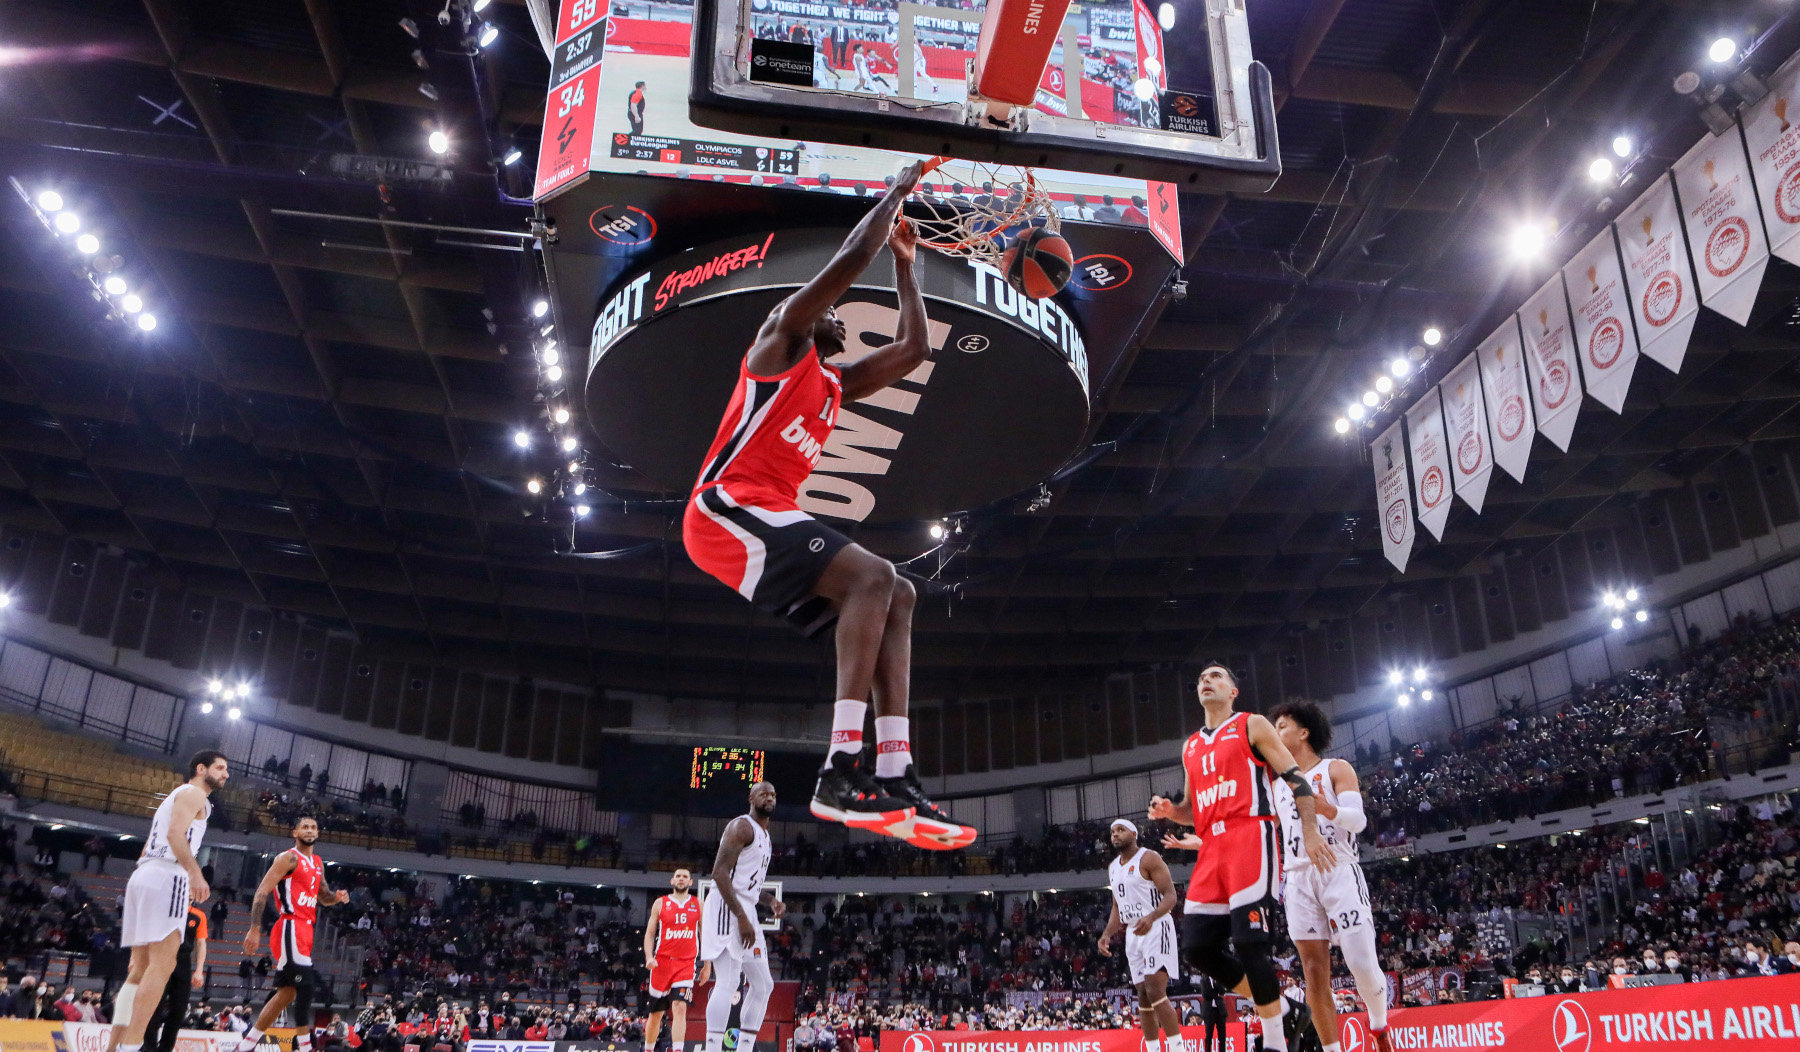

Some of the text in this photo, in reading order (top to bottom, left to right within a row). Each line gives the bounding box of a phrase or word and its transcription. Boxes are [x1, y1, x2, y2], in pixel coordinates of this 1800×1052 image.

[571, 0, 597, 29] 59
[770, 1, 885, 22] TOGETHER WE FIGHT
[1023, 0, 1044, 35] INES
[566, 31, 593, 62] 2:37
[768, 61, 812, 71] oneteam
[558, 79, 585, 118] 34
[1168, 115, 1208, 127] TURKISH
[1168, 122, 1209, 134] AIRLINES
[630, 135, 655, 143] TURKISH
[630, 140, 668, 149] EuroLeague
[636, 150, 653, 159] 2:37
[667, 153, 675, 161] 12
[695, 143, 793, 161] OLYMPIACOS 59
[696, 156, 793, 173] LDLC ASVEL 34
[543, 173, 557, 189] TEAM
[1703, 197, 1737, 228] 1975-76
[599, 215, 637, 237] TGI
[1085, 263, 1115, 286] TGI
[589, 232, 775, 369] FIGHT STRONGER!
[964, 336, 981, 351] 21+
[882, 741, 907, 753] GSA
[735, 763, 746, 771] 34
[1202, 750, 1216, 776] 11
[310, 876, 316, 890] 2
[1118, 883, 1126, 898] 9
[674, 912, 687, 925] 16
[1338, 909, 1362, 930] 32
[665, 926, 694, 940] bwin
[1149, 956, 1155, 969] 9
[1599, 1010, 1714, 1043] TURKISH
[1431, 1020, 1506, 1050] AIRLINES
